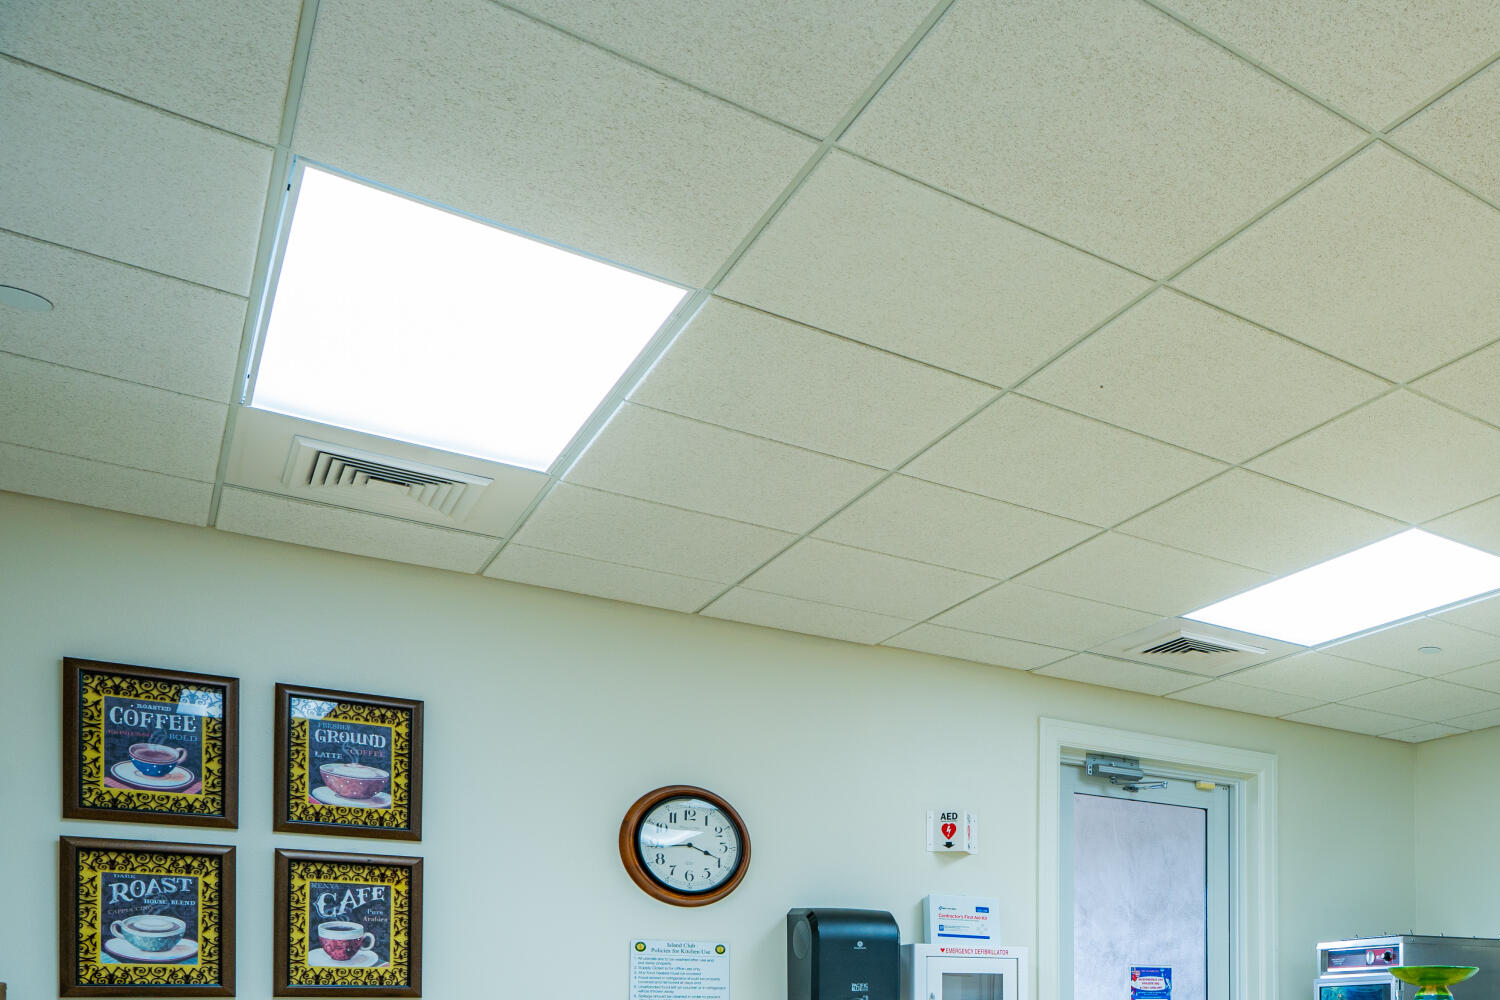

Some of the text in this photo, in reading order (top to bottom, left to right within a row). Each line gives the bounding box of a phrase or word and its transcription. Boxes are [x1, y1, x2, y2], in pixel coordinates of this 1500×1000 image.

[136, 703, 172, 712] ROASTED
[109, 706, 196, 732] COFFEE
[169, 733, 198, 742] BOLD
[314, 729, 386, 748] GROUND
[314, 751, 343, 759] LATTE
[669, 812, 677, 824] 11
[684, 809, 697, 821] 12
[704, 815, 708, 826] 1
[940, 812, 958, 820] AED
[714, 826, 723, 838] 2
[719, 842, 728, 854] 3
[655, 852, 665, 865] 8
[669, 865, 677, 876] 7
[684, 870, 695, 882] 6
[702, 867, 711, 879] 5
[108, 877, 193, 905] ROAST
[313, 886, 386, 918] CAFE
[945, 947, 1009, 956] EMERGENCY DEFIBRILLATOR
